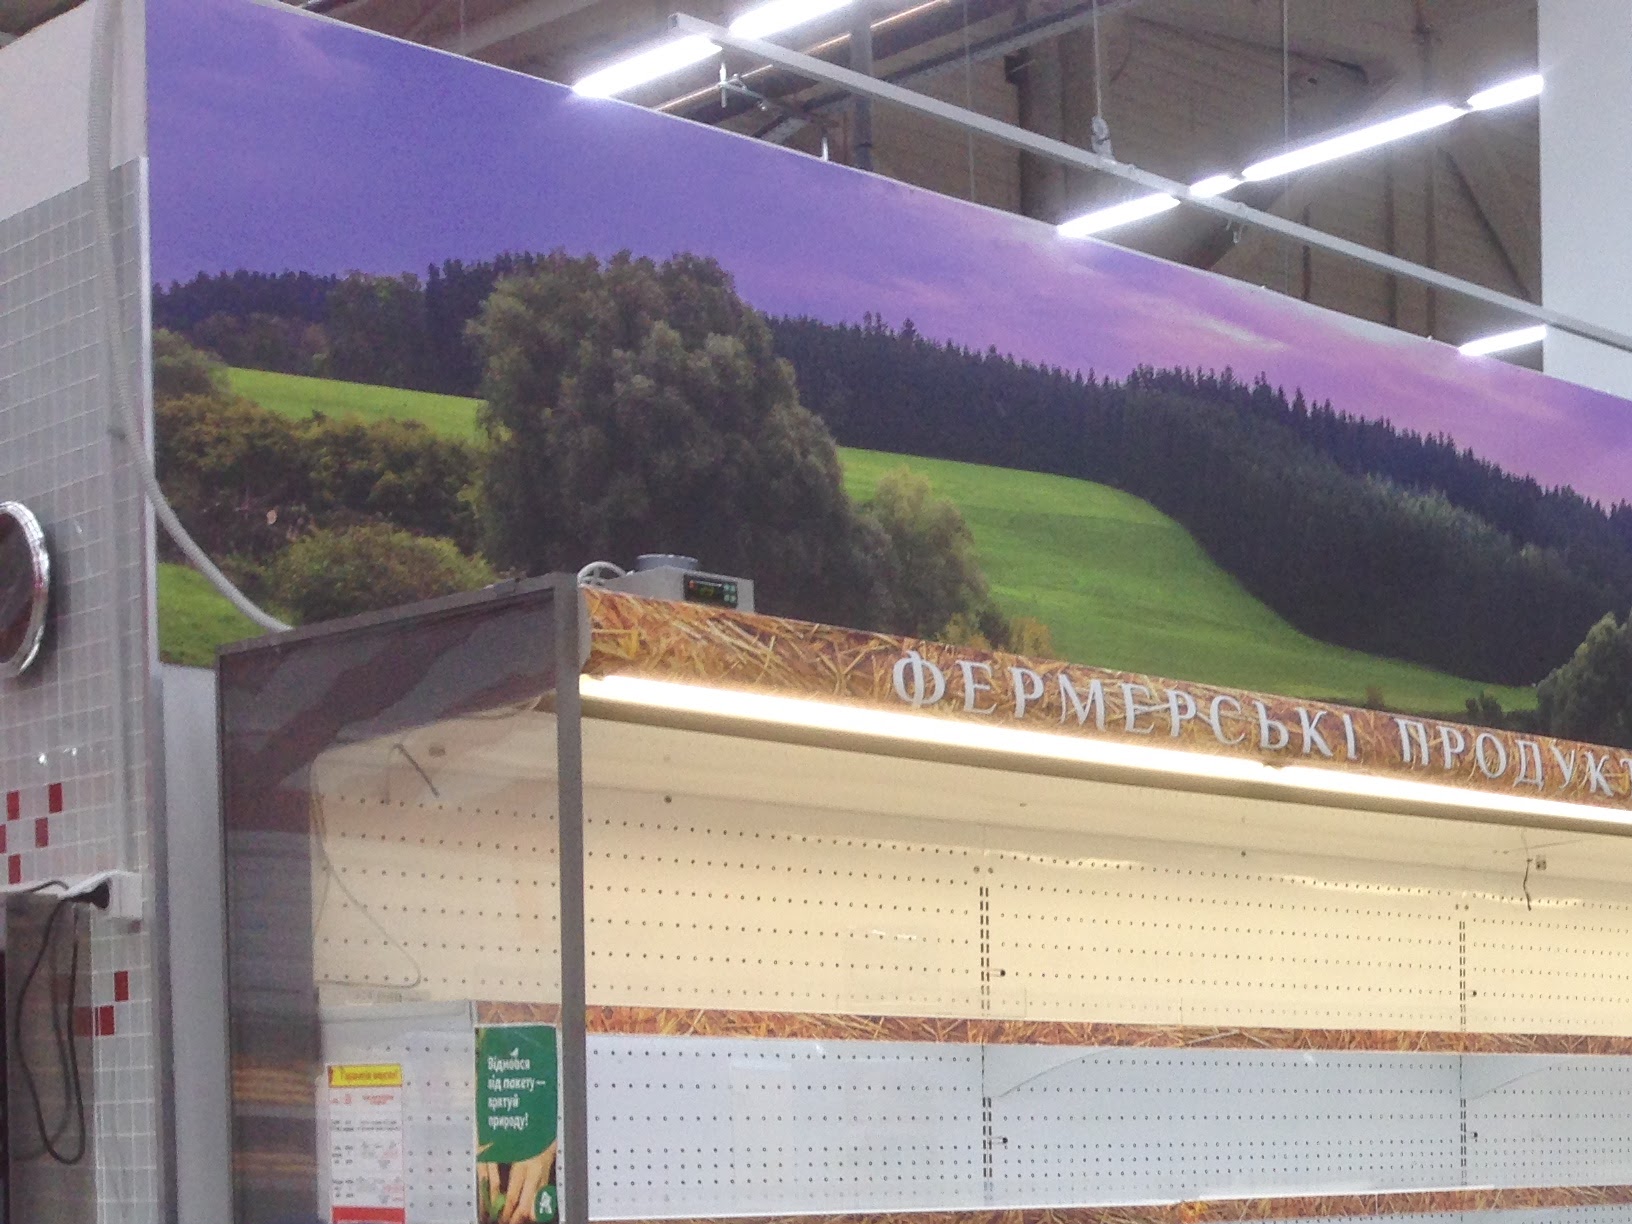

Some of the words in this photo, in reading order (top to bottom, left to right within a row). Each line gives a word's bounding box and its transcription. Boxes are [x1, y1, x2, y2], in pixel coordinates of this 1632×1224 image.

[892, 650, 1358, 760] ФЕРМЕРСЬКІ
[503, 1077, 535, 1092] пакету
[488, 1112, 529, 1131] природу!
